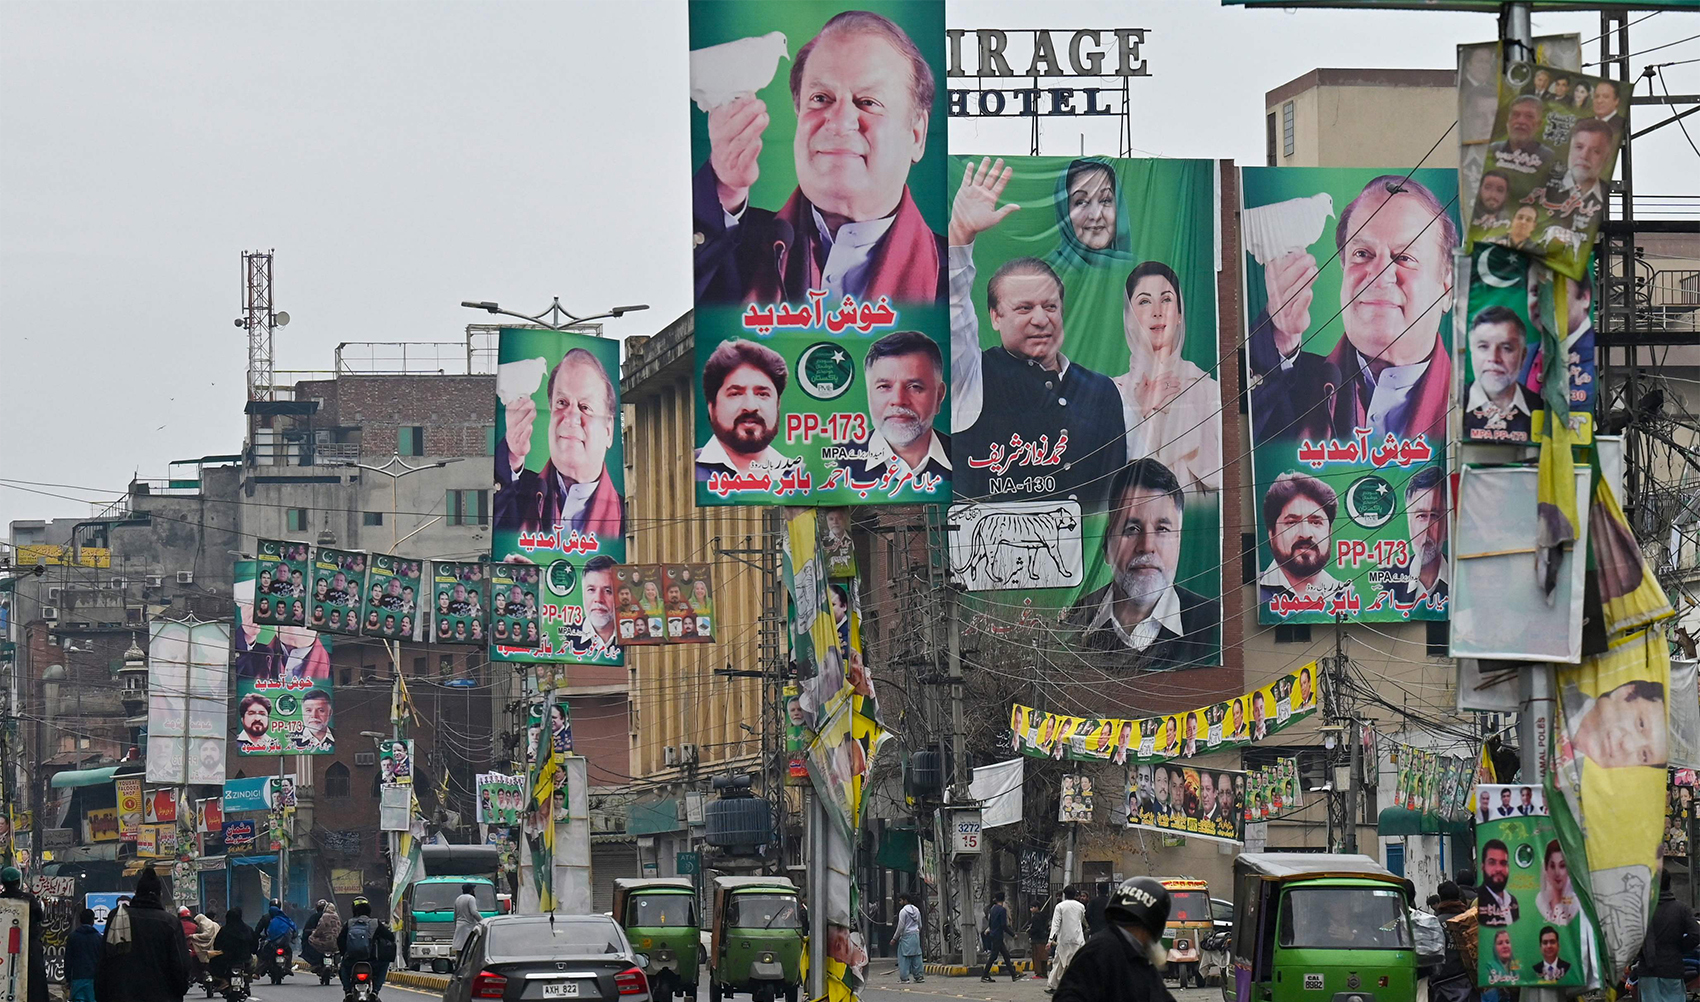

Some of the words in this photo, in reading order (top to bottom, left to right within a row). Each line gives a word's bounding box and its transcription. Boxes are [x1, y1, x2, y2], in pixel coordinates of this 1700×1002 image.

[948, 88, 1111, 116] HOTEL
[743, 290, 828, 333] آمدید
[826, 297, 895, 331] خوش
[1570, 390, 1587, 401] 30
[786, 414, 867, 442] PP-173
[1471, 429, 1493, 439] MPA
[822, 448, 847, 459] MPA
[968, 433, 1024, 475] شریف
[1020, 435, 1048, 466] نواز
[1042, 435, 1068, 465] محمد
[1298, 427, 1372, 467] آمدید
[1370, 432, 1432, 467] خوش
[708, 471, 772, 496] محمود
[775, 467, 811, 496] بابر
[818, 467, 850, 490] احمد
[851, 455, 913, 498] مرغوب
[912, 471, 941, 491] میاں
[989, 476, 1056, 494] NA-130
[519, 525, 564, 551] آمدید
[562, 529, 598, 554] خوش
[1337, 541, 1408, 566] PP-173
[1369, 572, 1391, 582] MPA
[1270, 593, 1325, 616] محمود
[1329, 591, 1360, 615] بابر
[1365, 589, 1395, 611] احمد
[254, 674, 287, 691] آمدید
[286, 676, 314, 691] خوش
[271, 721, 303, 733] PP-173
[232, 790, 260, 799] ZINDIGI
[958, 823, 980, 832] 3272
[962, 835, 977, 848] 15
[545, 986, 559, 994] AXH
